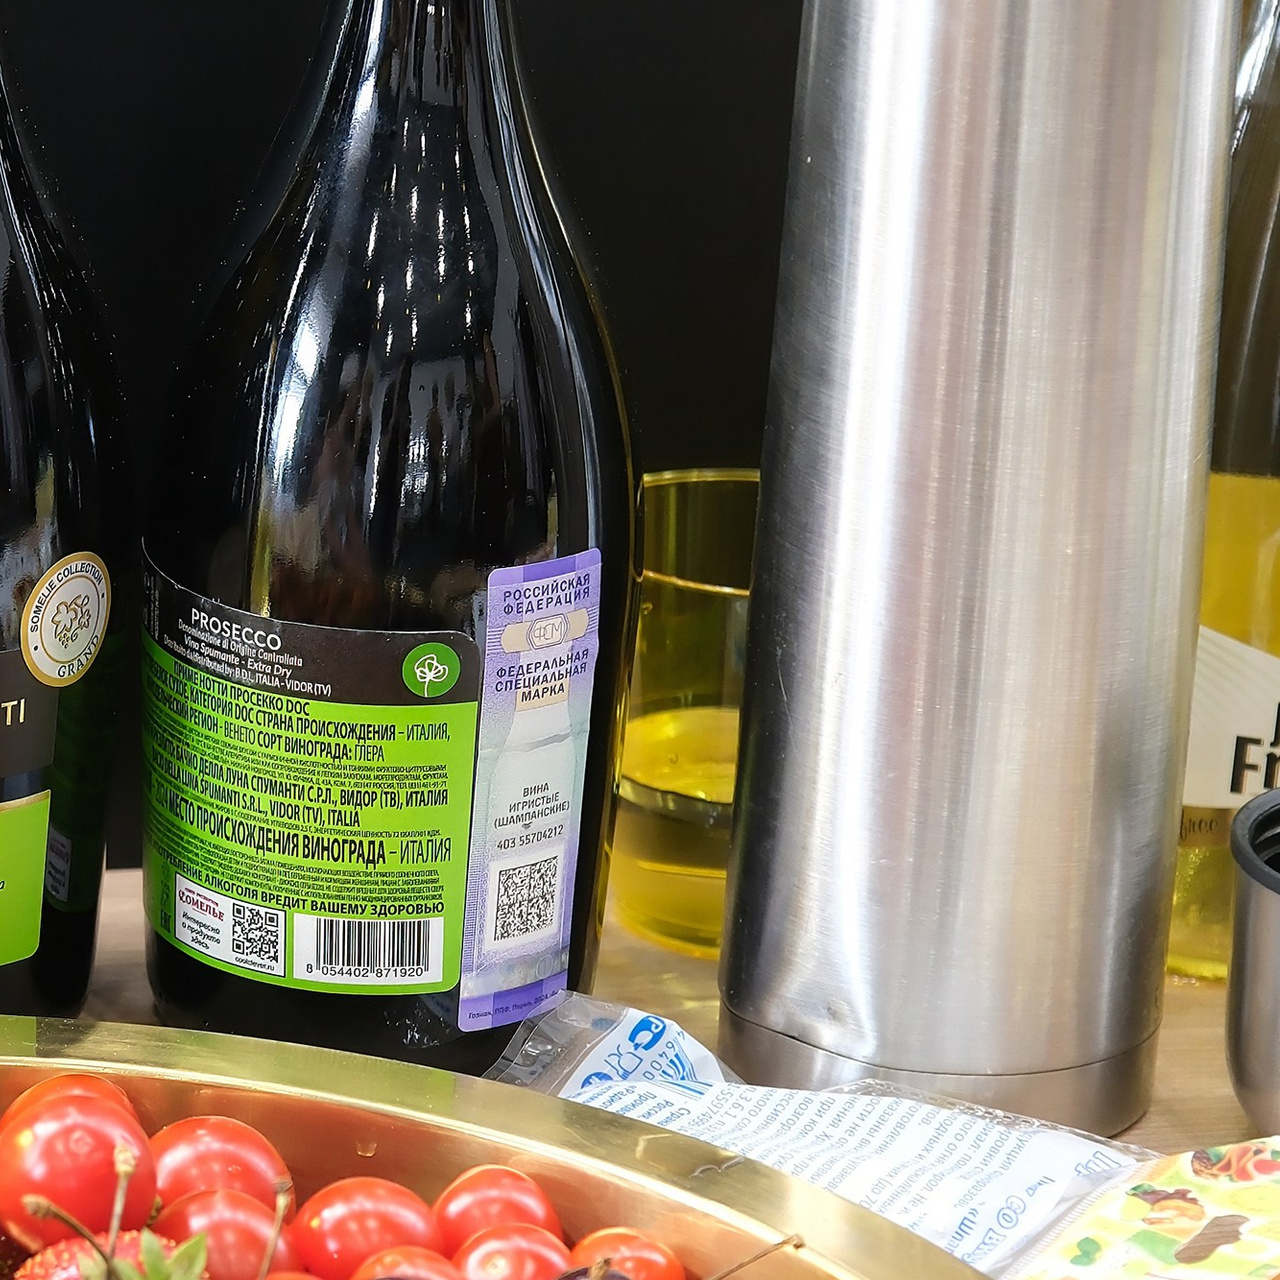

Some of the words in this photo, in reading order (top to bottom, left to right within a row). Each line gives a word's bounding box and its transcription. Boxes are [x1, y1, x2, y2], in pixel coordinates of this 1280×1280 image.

[30, 580, 57, 633] SOMELIE
[57, 562, 104, 586] COLLECTION
[503, 573, 590, 602] РОССИЙСКАЯ
[503, 586, 590, 615] ФЕДЕРАЦИЯ
[191, 608, 281, 651] PROSECCO
[57, 634, 100, 678] GRAND
[184, 634, 199, 650] Vino
[200, 642, 240, 665] Spumante
[247, 658, 272, 673] Extra
[274, 665, 293, 678] Dry
[496, 648, 589, 679] ФЕДЕРАЛЬНАЯ
[174, 660, 198, 685] ПРИМЕ
[200, 672, 228, 697] НОТТИ
[230, 685, 284, 712] ПРОСЕККО
[286, 699, 310, 716] DOC
[256, 673, 280, 688] ITALIA
[285, 679, 313, 693] VIDOR
[495, 662, 588, 692] СПЕЦИАЛЬНАЯ
[521, 683, 565, 703] МАРКА
[190, 684, 233, 718] КАТЕГОРИЯ
[234, 704, 254, 724] DOC
[255, 709, 294, 735] СТРАНА
[296, 717, 396, 744] ПРОИСХОЖДЕНИЯ
[406, 723, 451, 742] ИТАЛИЯ,
[190, 707, 219, 734] РЕГИОН
[224, 721, 256, 745] ВЕНЕТО
[257, 730, 282, 751] СОРТ
[284, 736, 352, 764] ВИНОГРАДА:
[354, 744, 385, 762] ГЛЕРА
[198, 756, 224, 782] ДЕЛЛА
[225, 767, 249, 790] ЛУНА
[251, 774, 305, 802] СПУМАНТИ
[340, 789, 377, 810] ВИДОР
[406, 789, 448, 807] ИТАЛИЯ
[523, 782, 549, 798] ВИНА
[200, 779, 240, 808] SPUMANTI
[269, 799, 301, 820] VIDOR
[327, 809, 361, 827] ITALIA
[494, 800, 570, 829] (ШАМПАНСКИЕ)
[508, 791, 560, 813] ИГРИСТЫЕ
[169, 787, 195, 825] МЕСТО
[196, 806, 300, 858] ПРОИСХОЖДЕНИЯ
[302, 834, 386, 870] ВИНОГРАДА
[400, 838, 451, 865] ИТАЛИЯ
[496, 837, 516, 851] 403
[519, 824, 564, 847] 55704212
[204, 873, 258, 901] АЛКОГОЛЯ
[260, 888, 308, 910] ВРЕДИТ
[310, 900, 368, 916] ВАШЕМУ
[370, 901, 445, 918] ЗДОРОВЬЮ
[306, 963, 313, 974] 8
[322, 966, 369, 978] 054402
[375, 967, 424, 978] 871920
[656, 1107, 691, 1127] Страна
